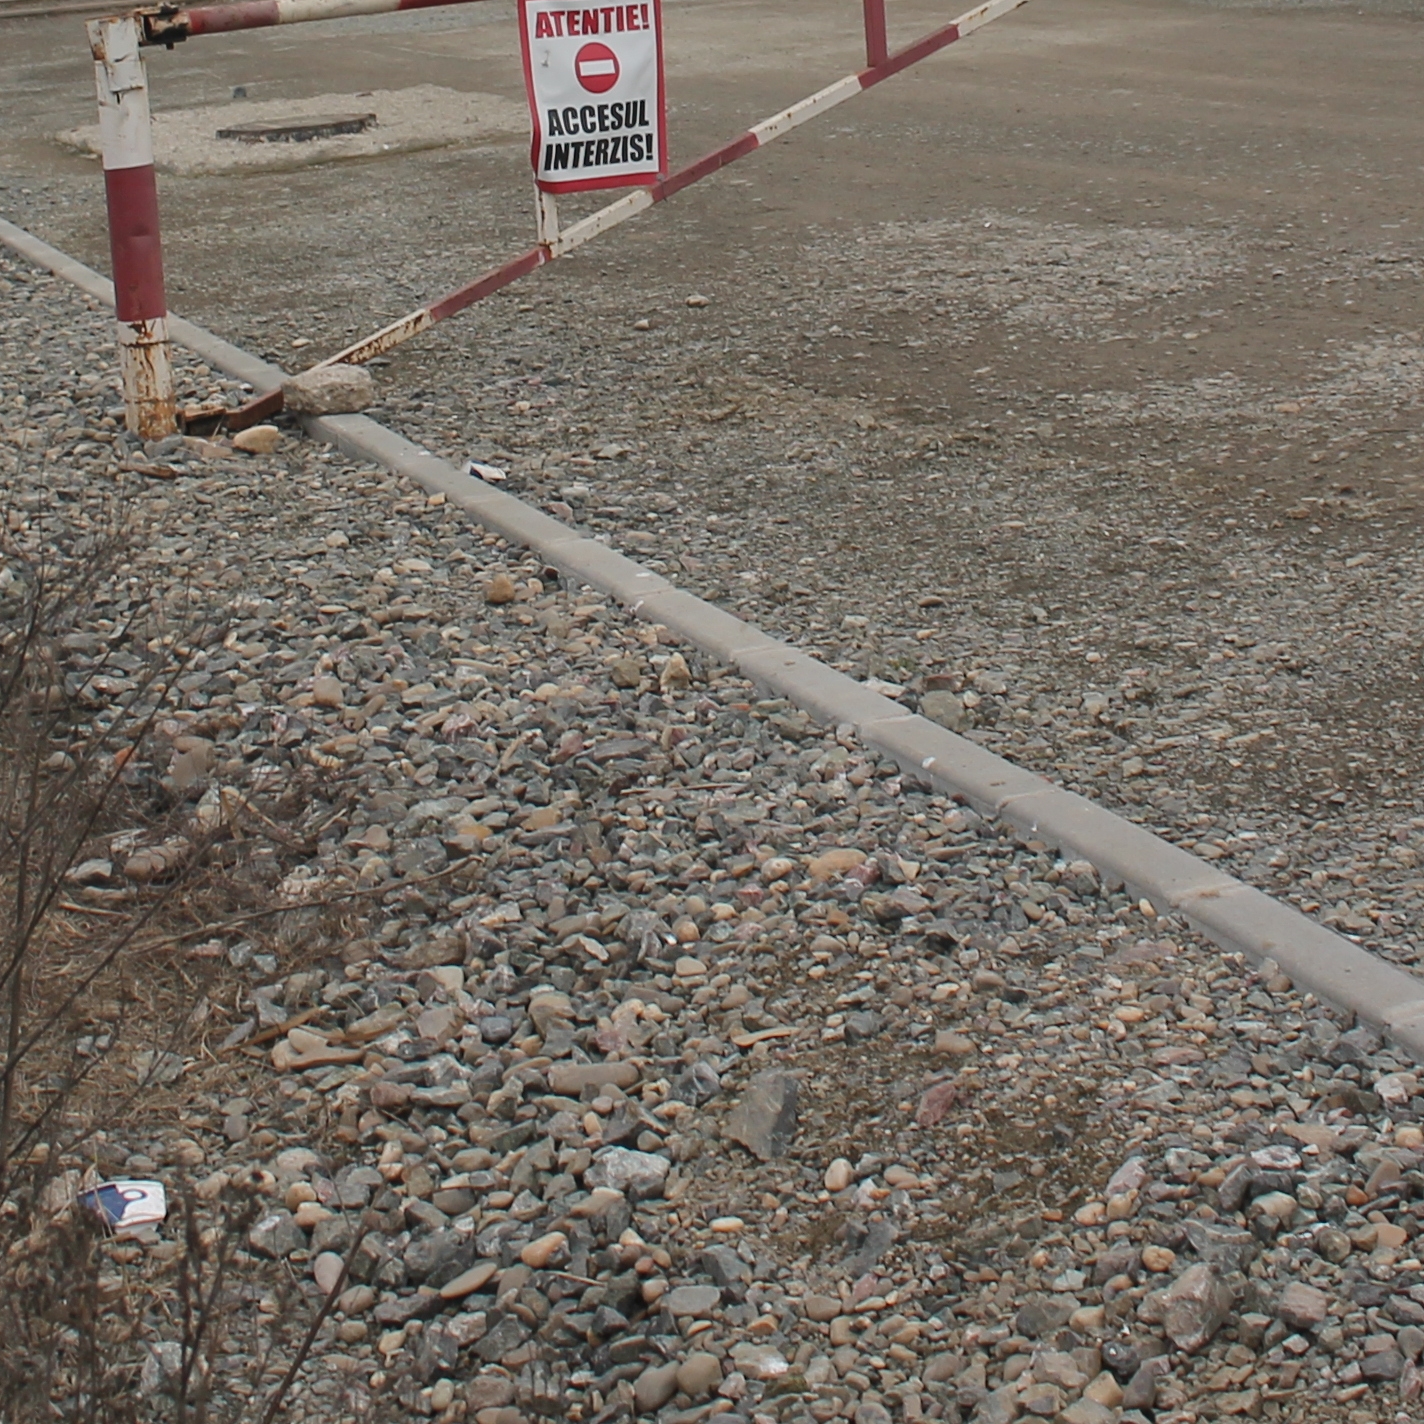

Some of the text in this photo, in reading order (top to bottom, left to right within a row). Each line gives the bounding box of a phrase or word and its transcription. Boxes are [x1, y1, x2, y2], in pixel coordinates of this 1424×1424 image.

[535, 4, 650, 39] ATENTIE!
[548, 100, 649, 136] ACCESUL
[544, 134, 653, 171] INTERZIS!
